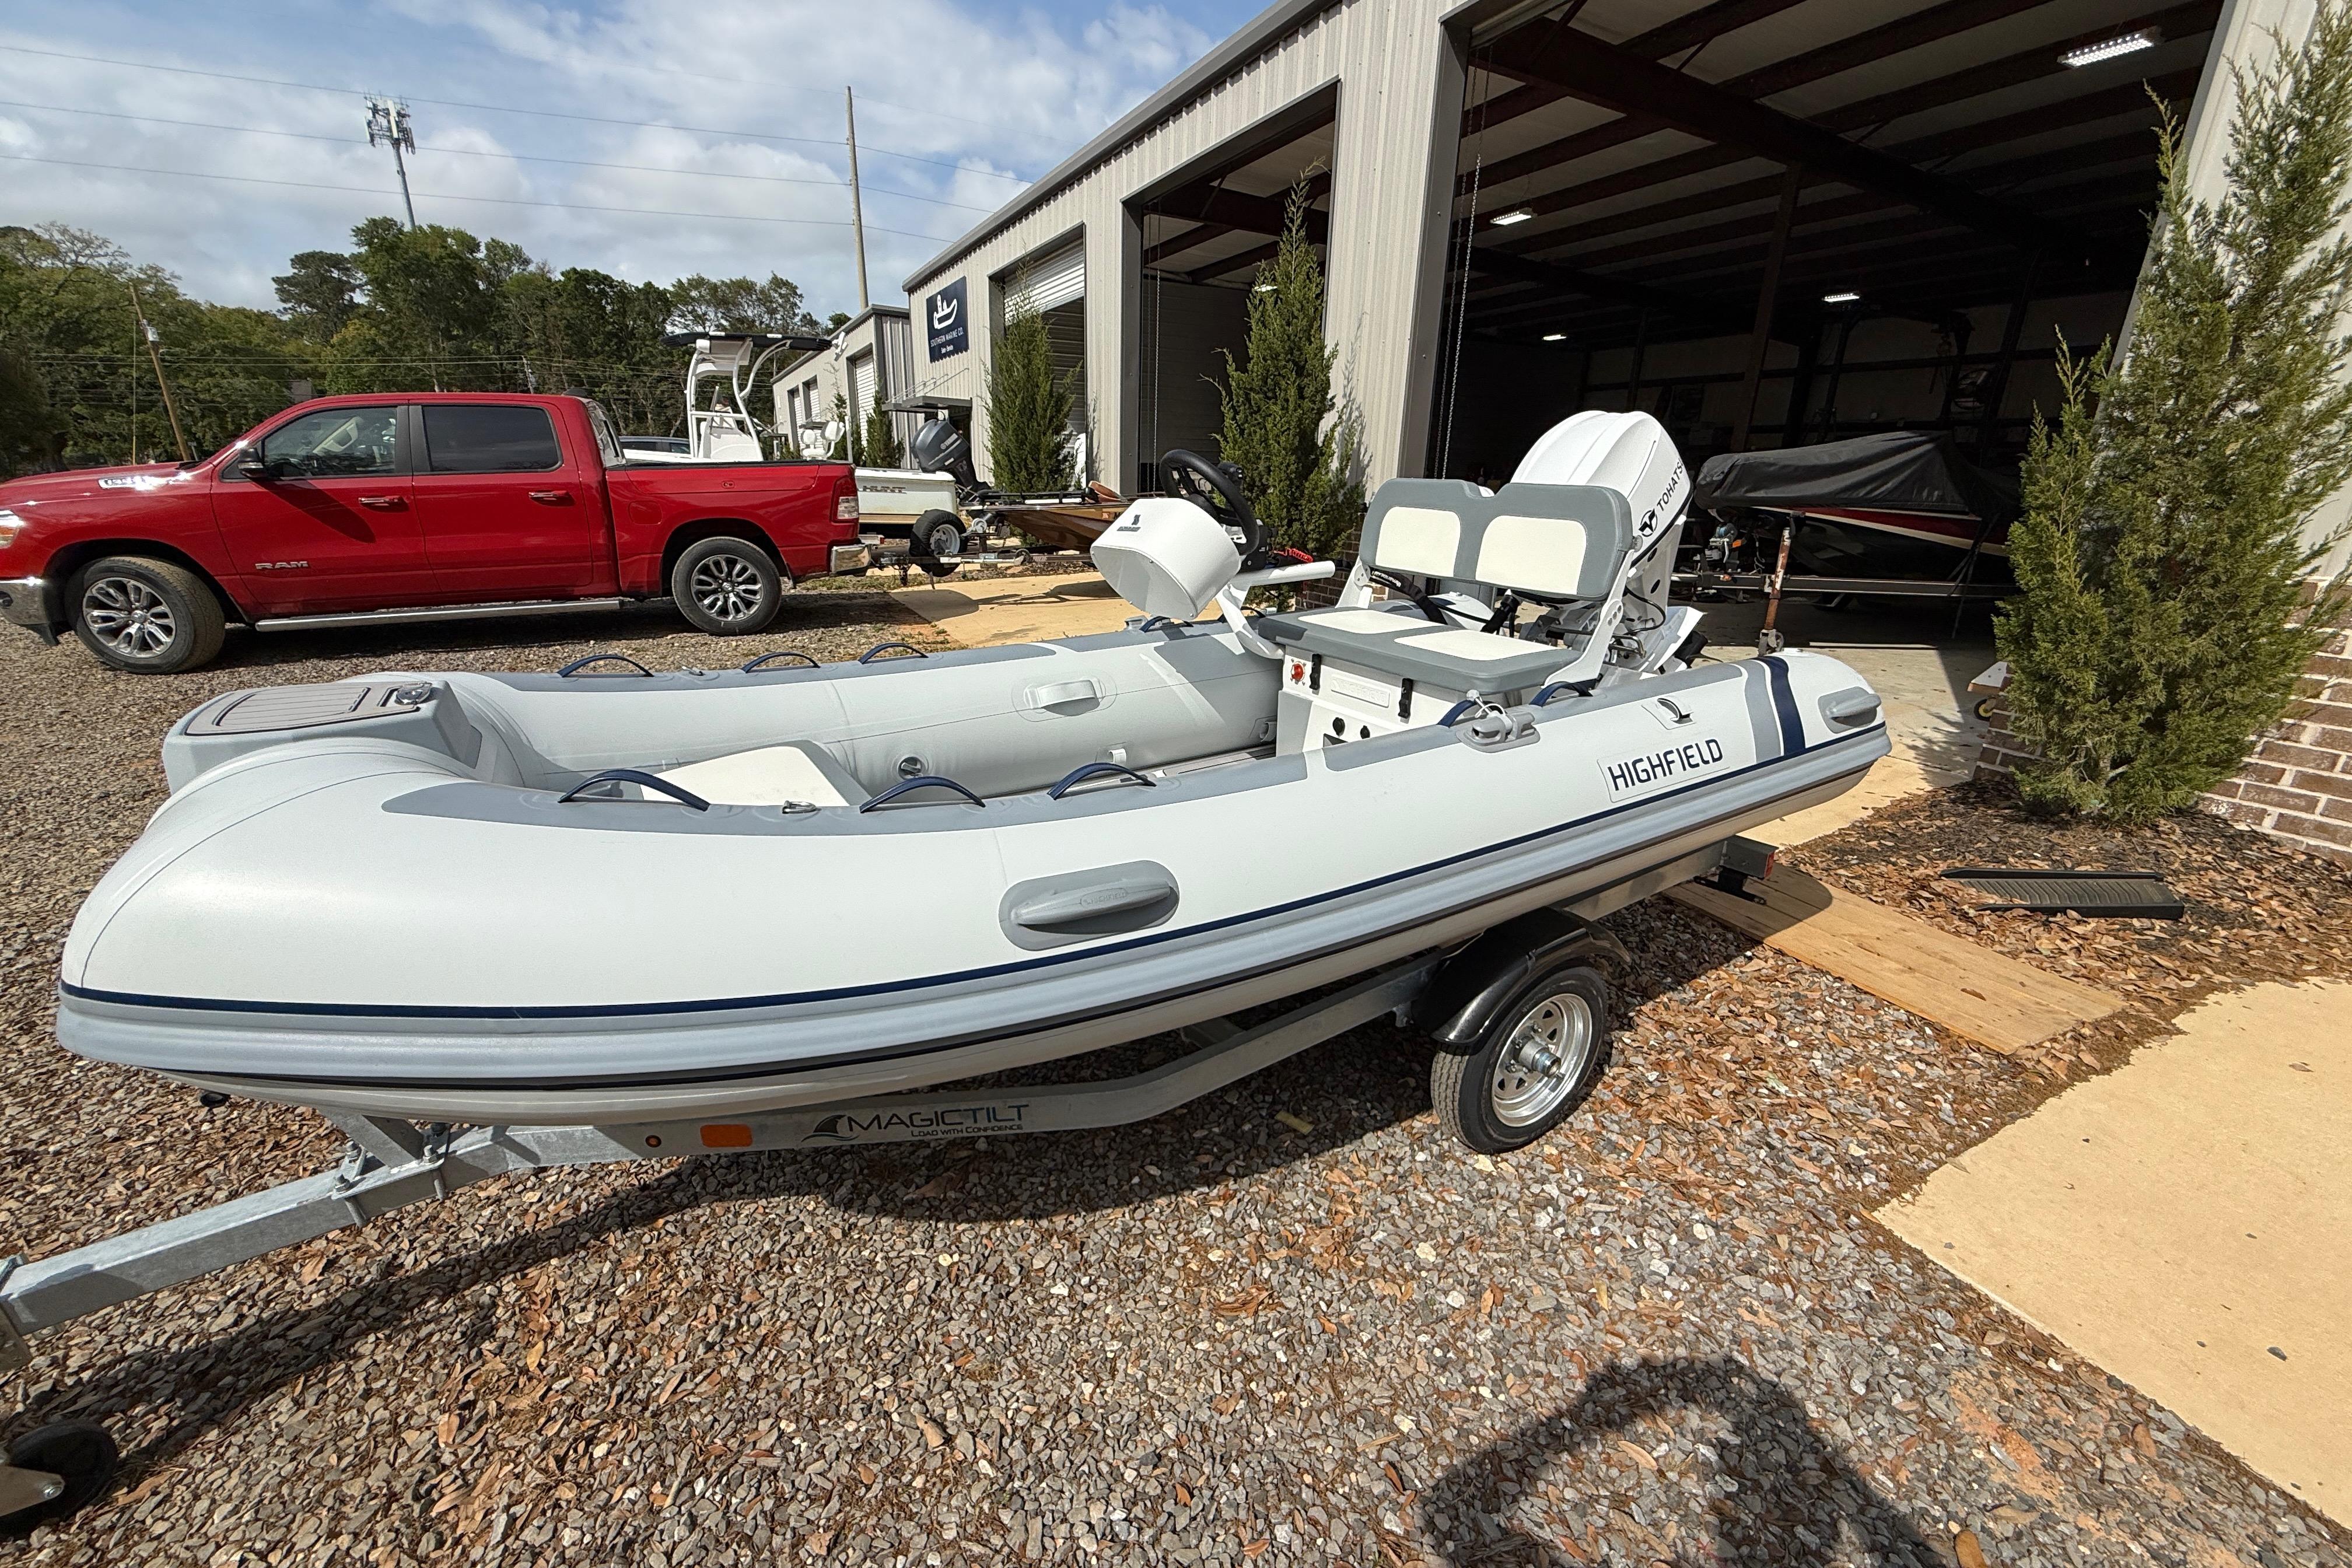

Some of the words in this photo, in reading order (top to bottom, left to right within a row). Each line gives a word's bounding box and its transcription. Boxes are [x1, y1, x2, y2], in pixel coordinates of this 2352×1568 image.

[946, 329, 958, 340] MARINE
[863, 485, 906, 494] HUNT
[255, 561, 309, 569] RAM
[1607, 738, 1723, 791] HIGHFIELD
[847, 1104, 1030, 1132] MAGICTILT
